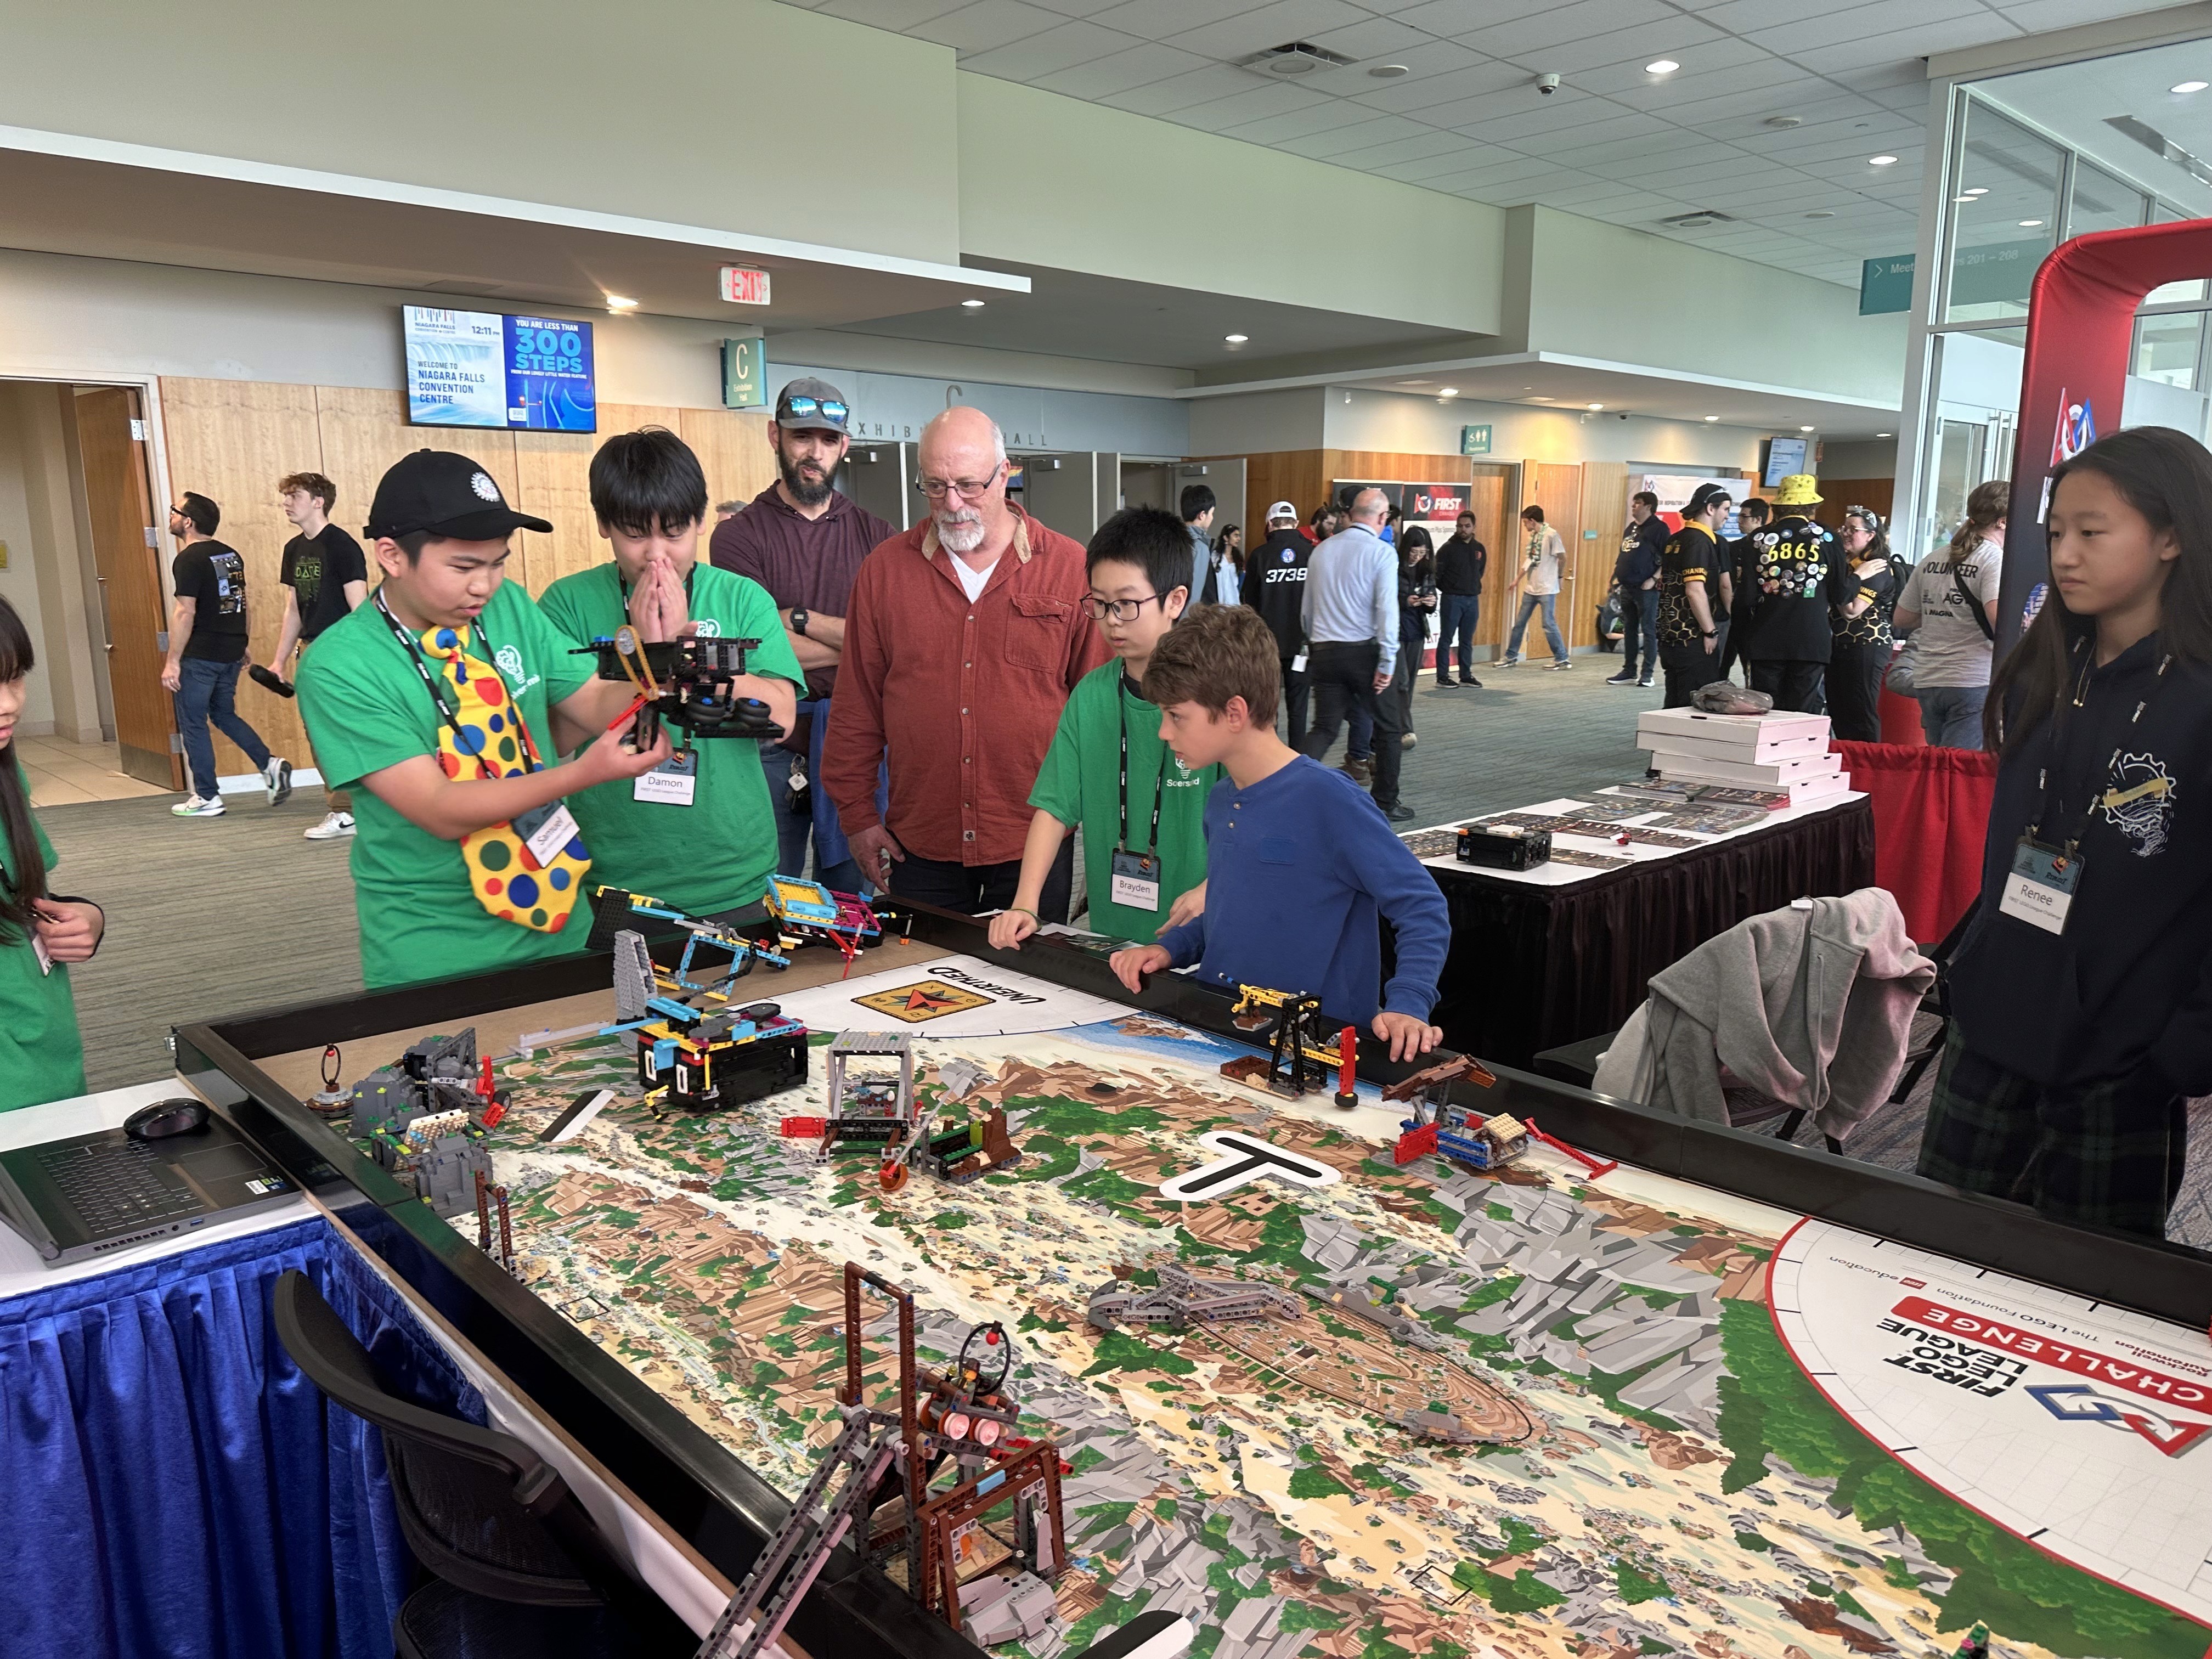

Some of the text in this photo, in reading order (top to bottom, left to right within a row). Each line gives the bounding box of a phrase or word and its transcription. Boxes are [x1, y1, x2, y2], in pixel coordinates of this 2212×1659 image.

[1891, 263, 1915, 274] Meet
[1967, 254, 1985, 264] 201
[731, 269, 763, 303] EXIT
[471, 326, 492, 335] 12:11
[516, 319, 529, 328] YOU
[545, 322, 560, 330] LESS
[561, 324, 578, 332] THAN
[515, 328, 582, 357] 300
[417, 360, 448, 369] WELCOME
[515, 353, 583, 373] STEPS
[736, 343, 748, 380] C
[419, 370, 485, 383] NIAGARA FALLS
[419, 382, 474, 394] CONVENTION
[420, 393, 454, 404] CENTRE
[1434, 498, 1462, 510] FIRST
[1768, 542, 1820, 562] 6865
[1266, 567, 1308, 583] 3739
[648, 776, 682, 788] Damon
[1120, 880, 1150, 895] Brayden
[2021, 884, 2053, 906] Renee
[927, 967, 1047, 1004] UNEARTHED
[1830, 1256, 1899, 1280] education
[1937, 1288, 2099, 1342] The LEGO Foundation
[1875, 1318, 2029, 1375] LEAGUE
[1922, 1308, 2205, 1401] CHALLENGE
[1912, 1346, 2018, 1387] LEGO
[2131, 1351, 2208, 1377] Rockwell
[1882, 1356, 2006, 1397] FIRST
